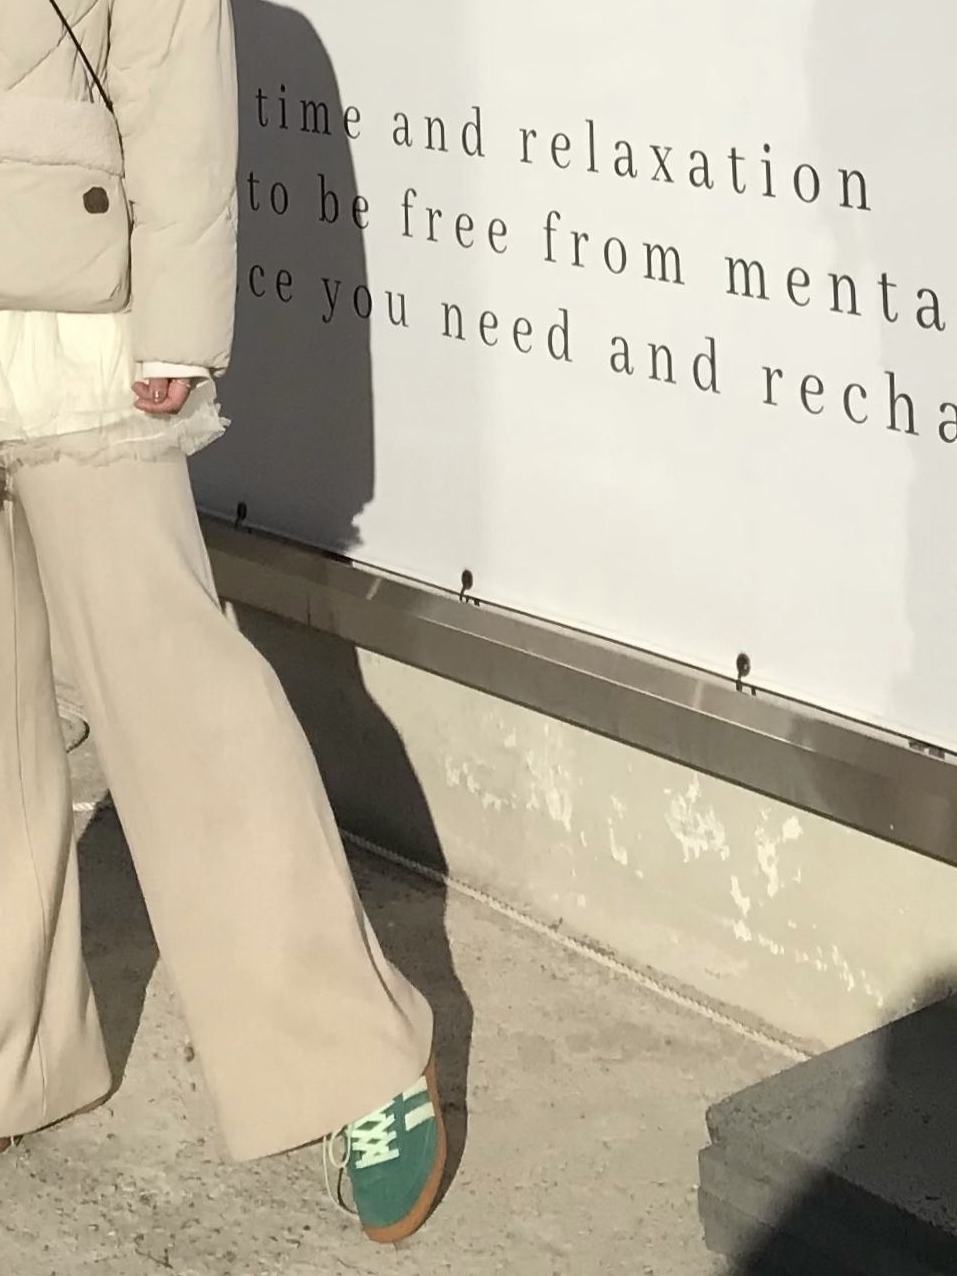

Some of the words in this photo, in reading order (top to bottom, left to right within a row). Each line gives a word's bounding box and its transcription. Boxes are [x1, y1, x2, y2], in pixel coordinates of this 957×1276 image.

[255, 83, 361, 140] time
[391, 105, 486, 158] and
[519, 118, 873, 212] relaxation
[247, 171, 289, 215] to
[317, 172, 370, 230] be
[401, 187, 509, 254] free
[543, 210, 686, 287] from
[236, 264, 293, 303] ce
[321, 277, 409, 328] you
[441, 299, 573, 363] need
[609, 336, 722, 395] and
